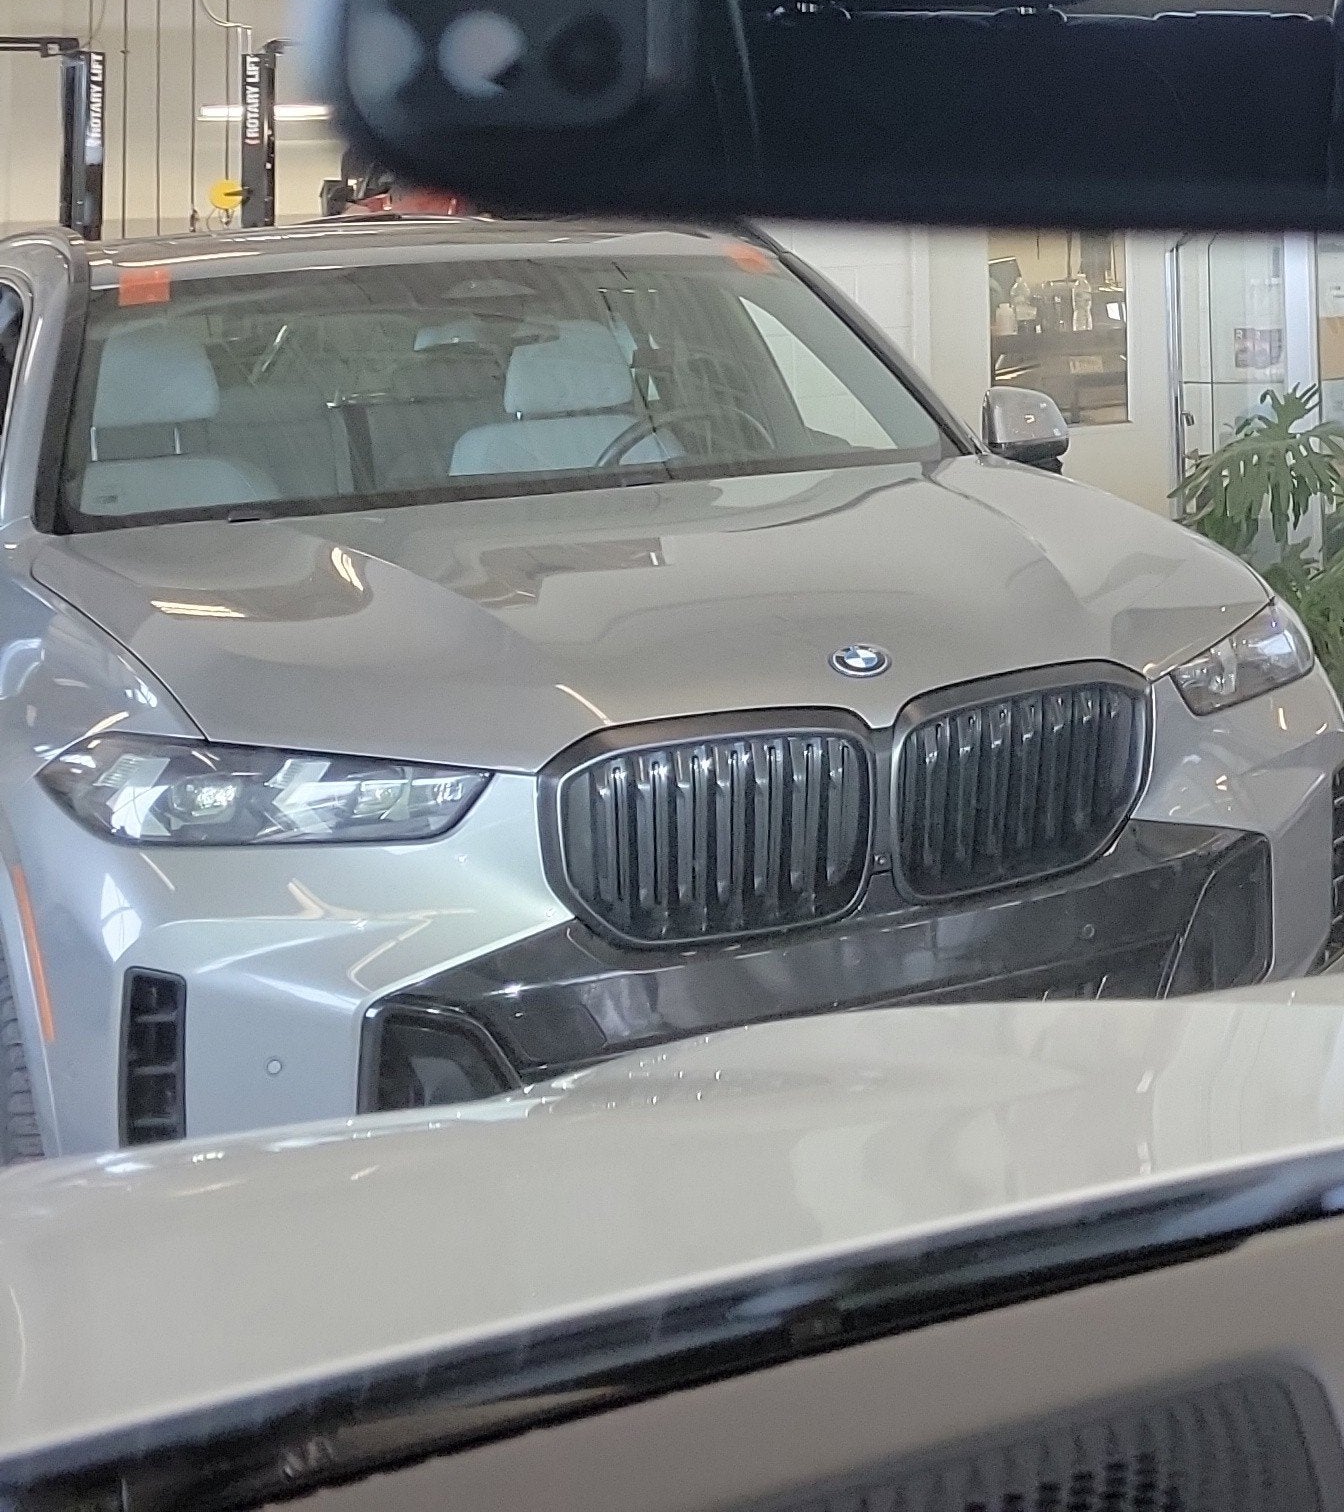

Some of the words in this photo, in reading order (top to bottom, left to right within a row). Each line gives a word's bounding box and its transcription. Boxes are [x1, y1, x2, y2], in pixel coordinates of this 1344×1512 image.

[90, 52, 103, 81] LIFT
[245, 55, 261, 83] LIFT
[89, 84, 103, 138] ROTARY
[245, 85, 261, 138] ROTARY
